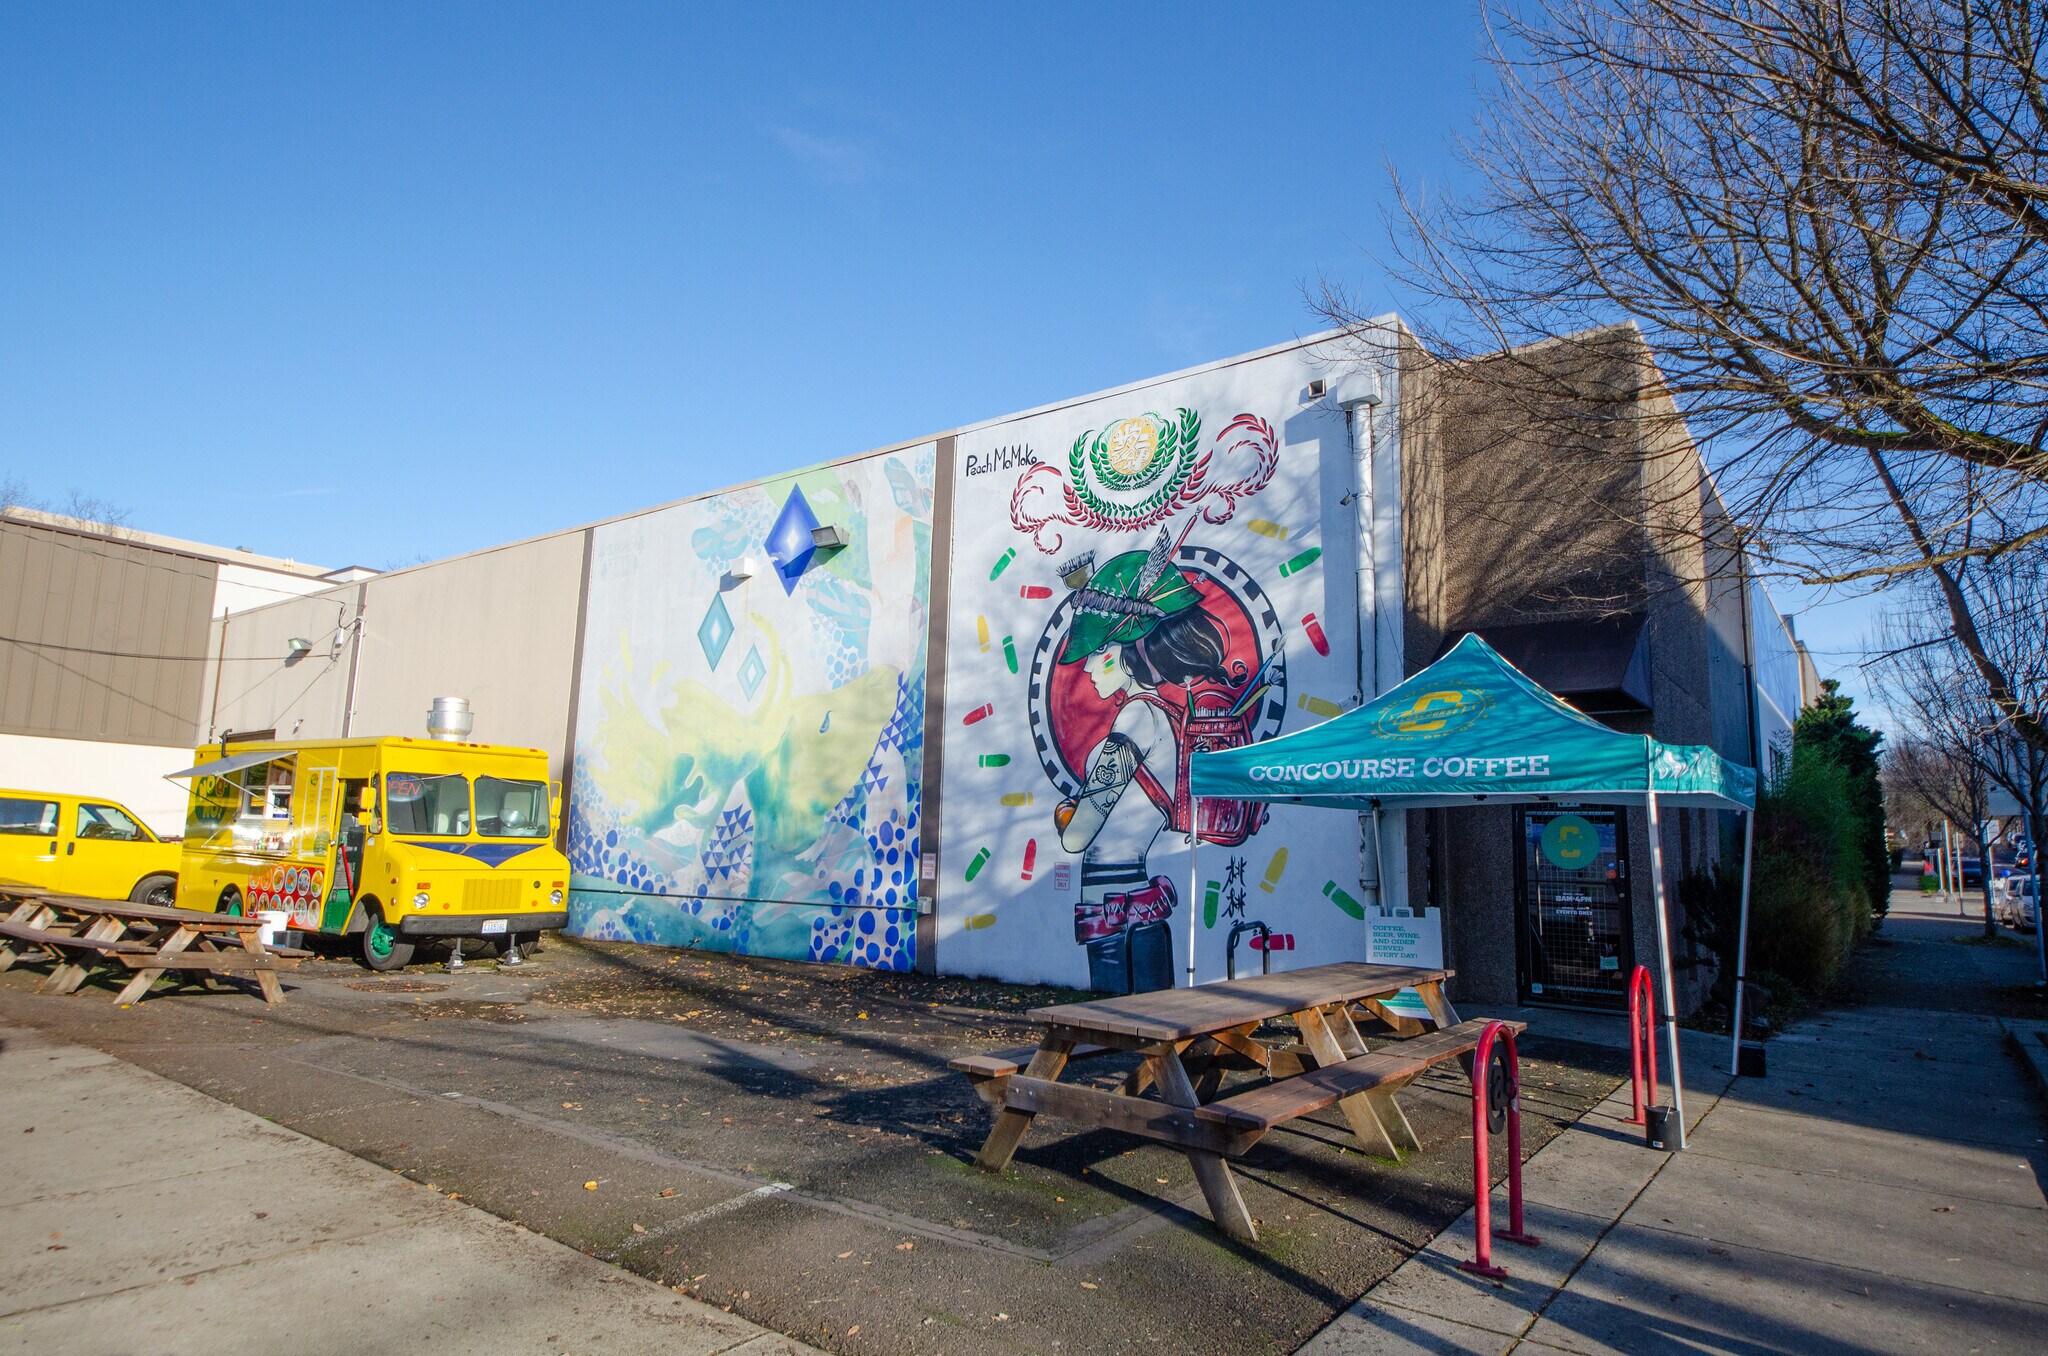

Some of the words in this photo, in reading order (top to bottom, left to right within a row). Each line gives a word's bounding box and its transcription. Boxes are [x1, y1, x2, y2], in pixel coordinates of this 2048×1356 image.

[966, 454, 992, 477] Peach
[993, 443, 1038, 472] MoMoko
[1249, 758, 1415, 782] CONCOURSE
[1423, 754, 1550, 778] COFFEE
[388, 780, 422, 797] PEN
